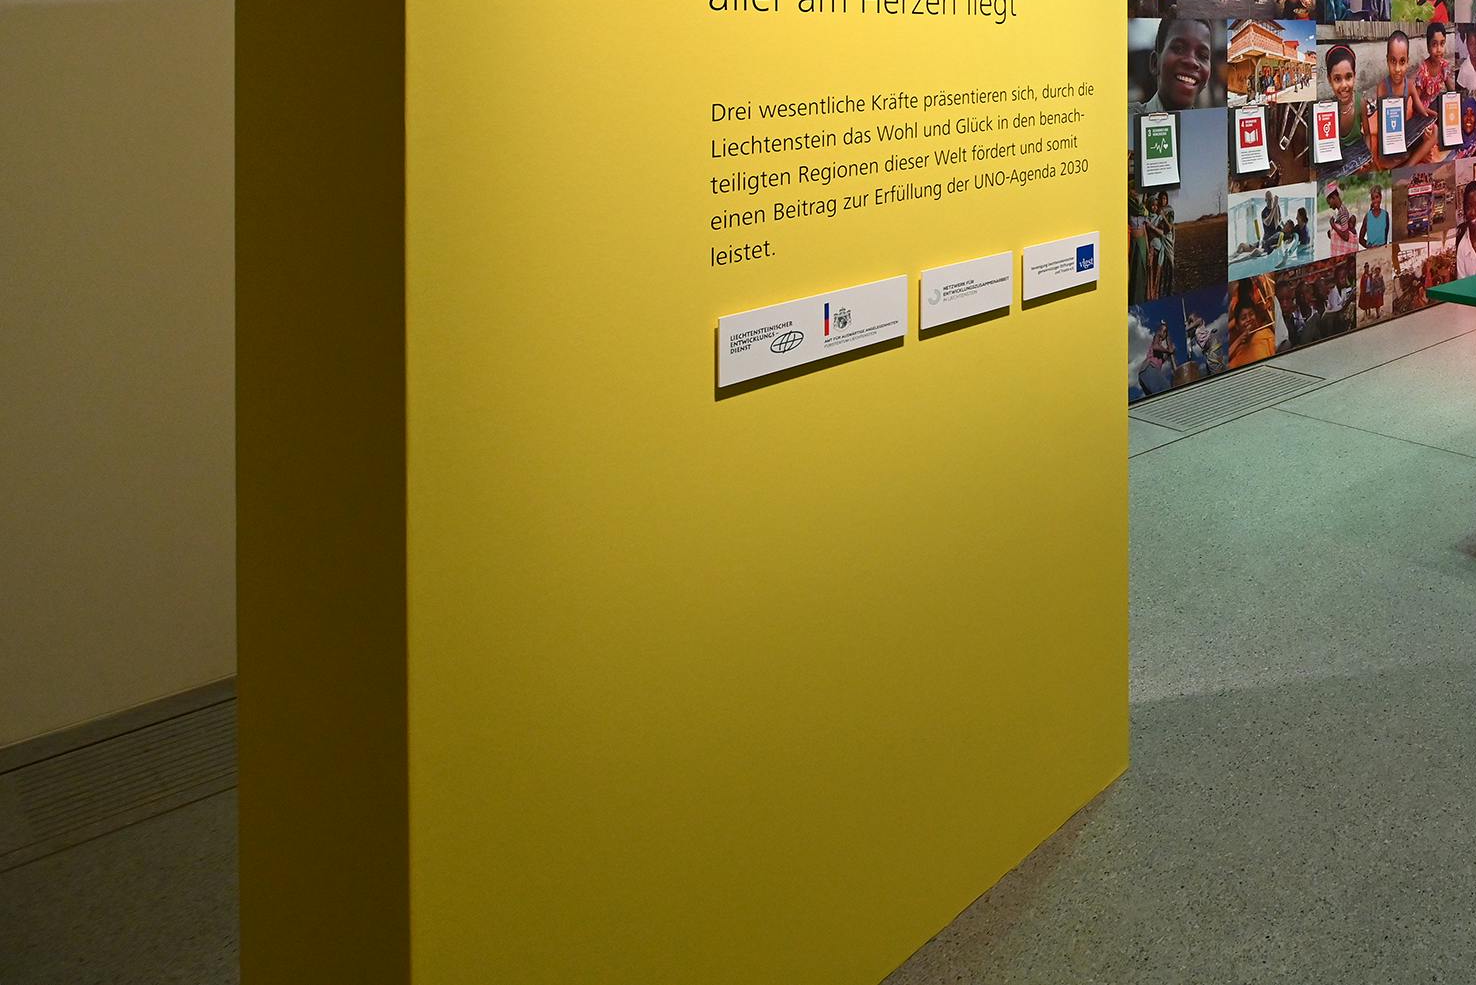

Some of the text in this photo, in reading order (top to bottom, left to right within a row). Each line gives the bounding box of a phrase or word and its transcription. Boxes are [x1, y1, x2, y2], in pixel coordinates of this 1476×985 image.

[711, 81, 1095, 122] Drei wesentliche Kräfte präsentieren sich, durch die
[711, 108, 1085, 158] Liechtenstein das Wohl und Glück in den benach-
[1147, 129, 1152, 137] 3
[710, 134, 1078, 195] teiligten Regionen dieser Welt fördert und somit
[710, 159, 1089, 230] einen Beitrag zur Erfüllung der UNO-Agenda 2030
[710, 240, 776, 268] leistet.
[729, 320, 794, 343] LIECHTENSTEINISCHER
[729, 343, 752, 355] DIENST
